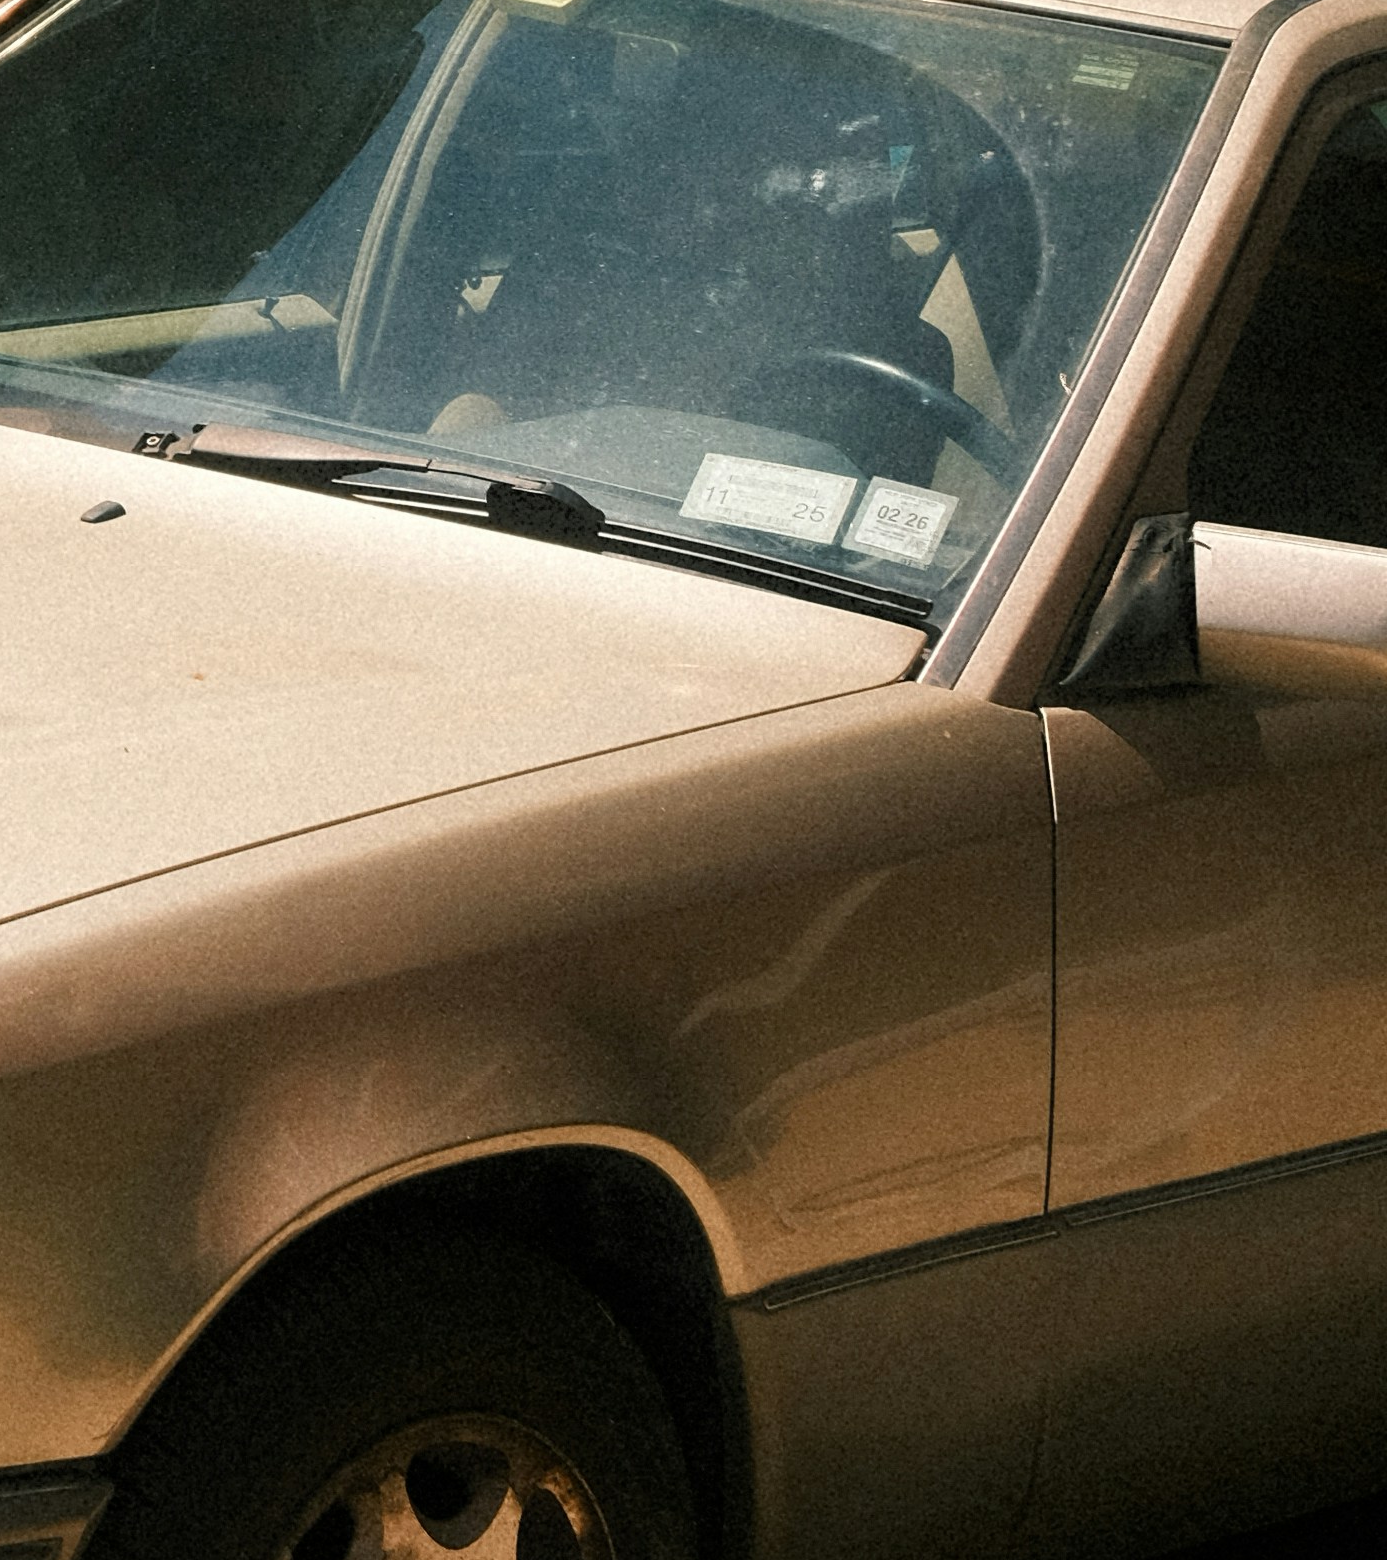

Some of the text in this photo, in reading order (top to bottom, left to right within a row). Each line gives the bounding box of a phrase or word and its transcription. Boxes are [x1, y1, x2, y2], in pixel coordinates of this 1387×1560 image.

[706, 486, 827, 523] 11 25
[877, 505, 930, 530] 02 26
